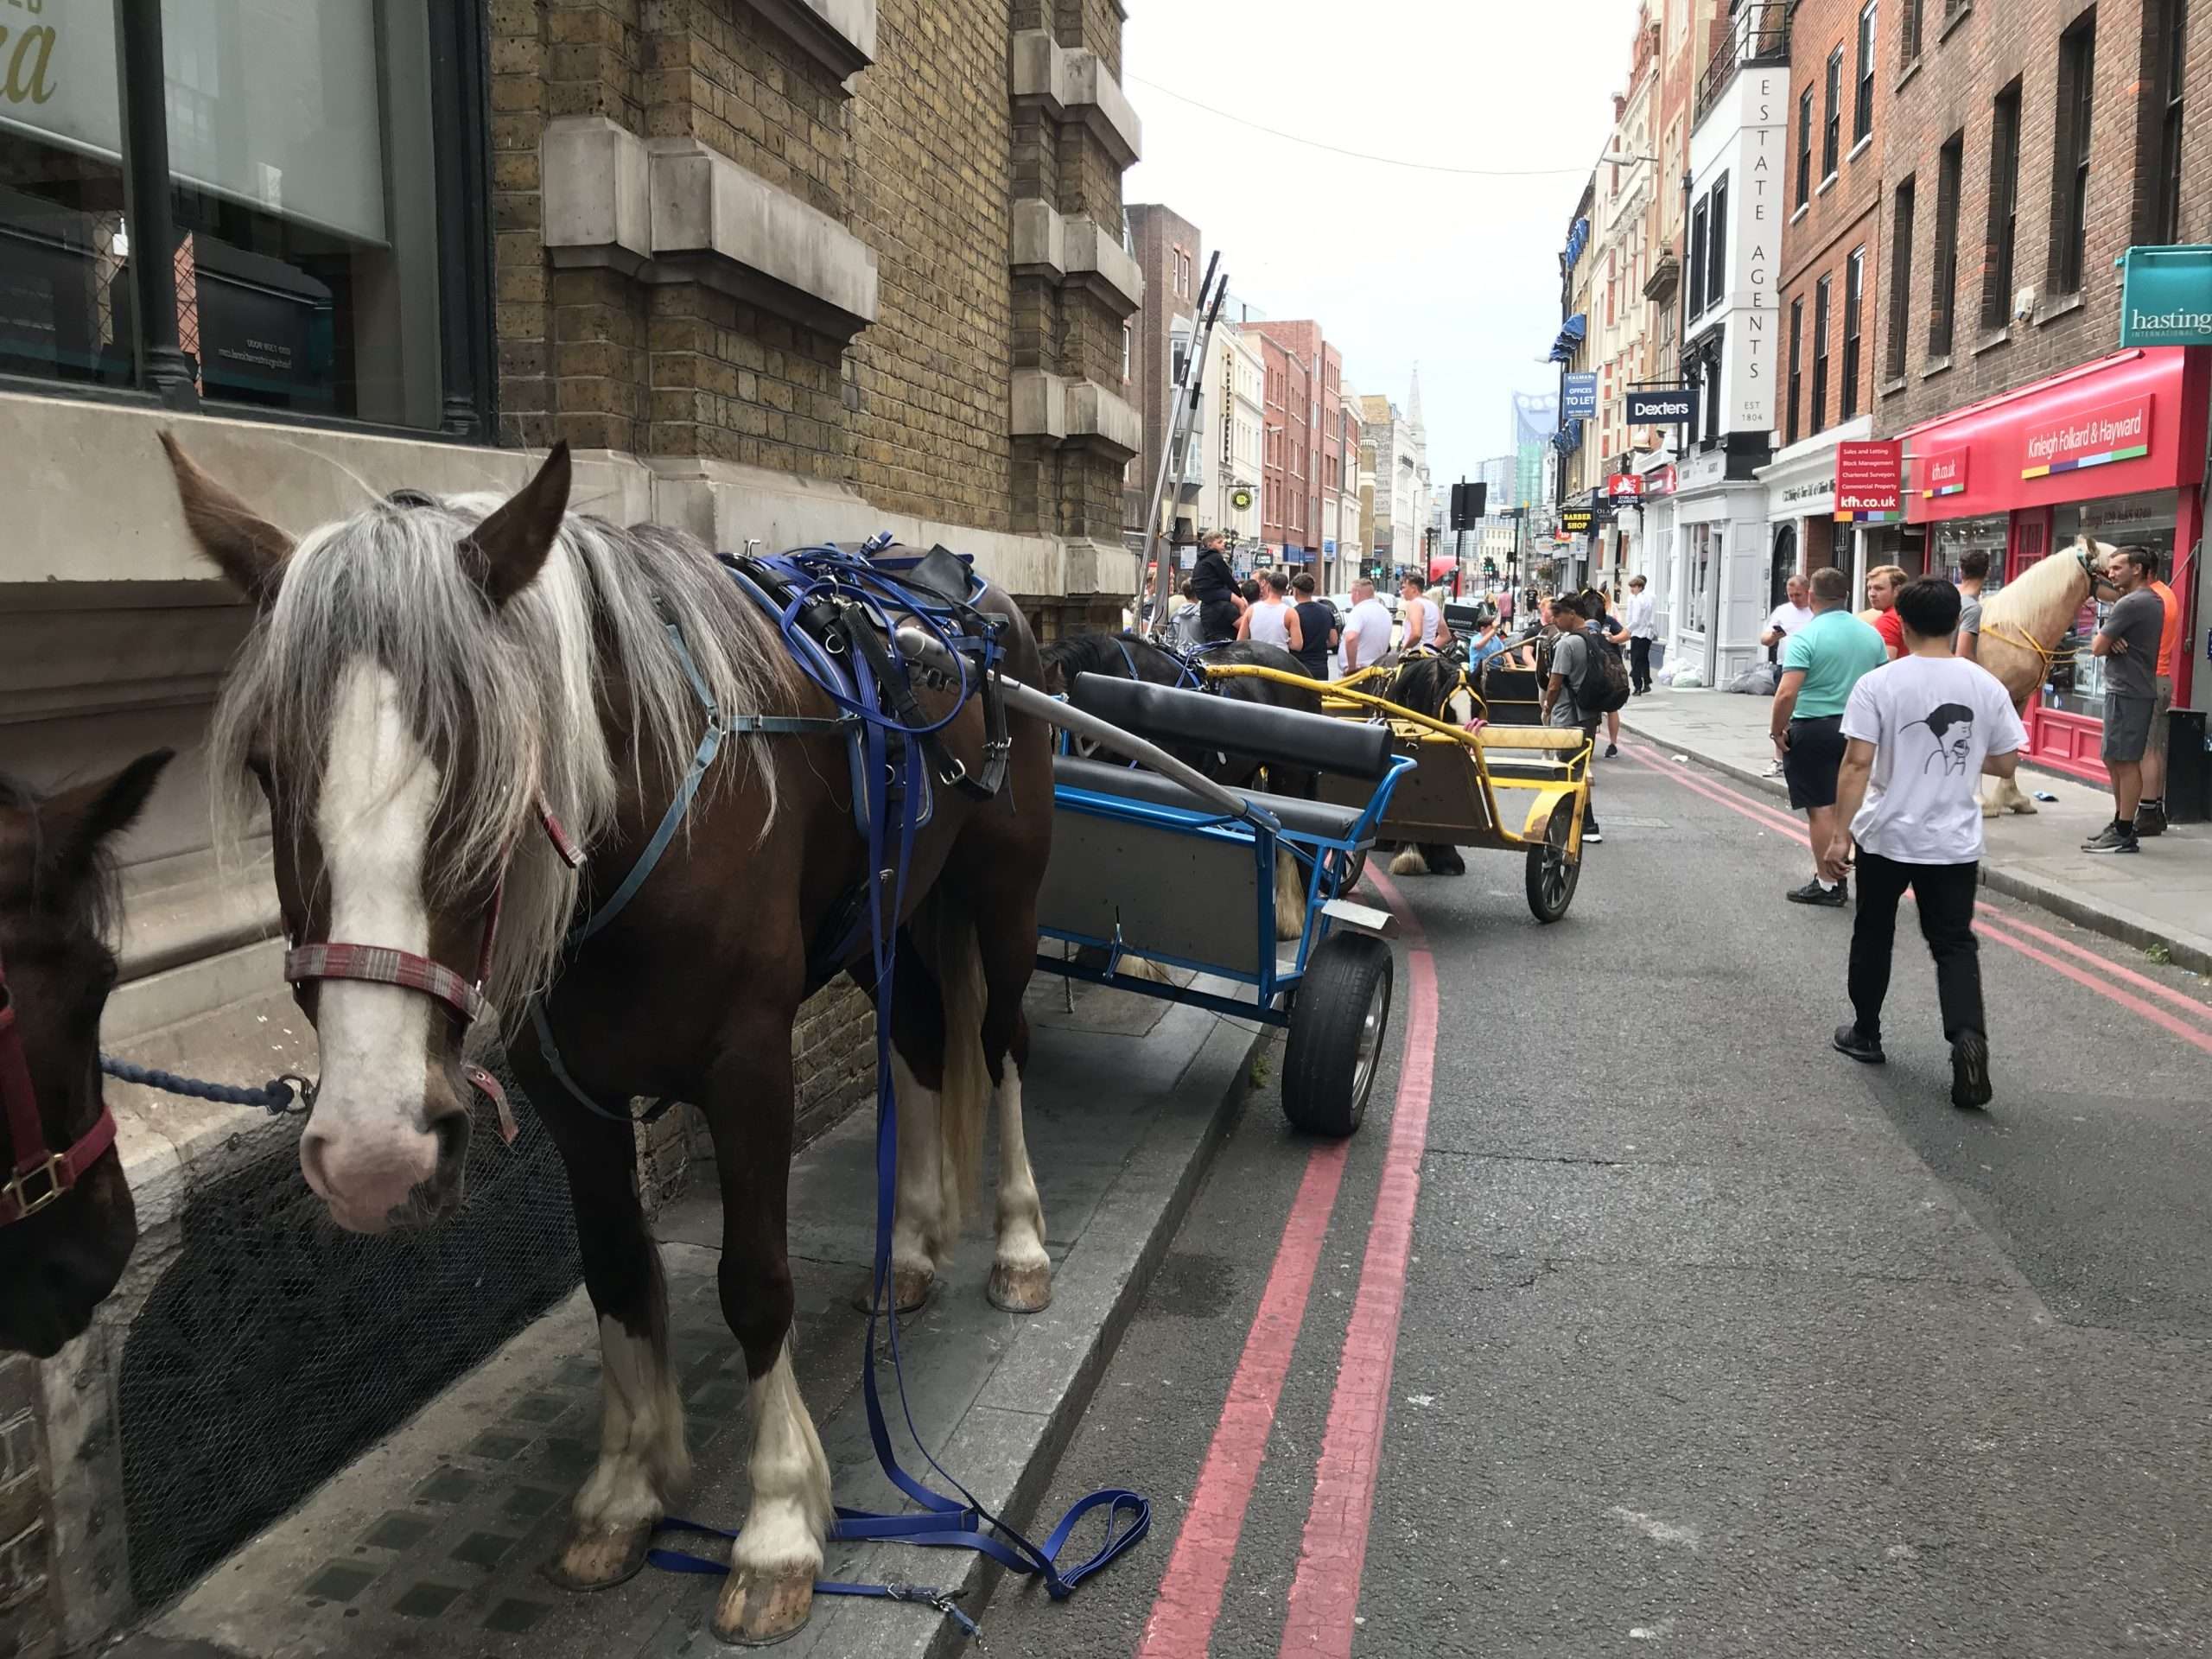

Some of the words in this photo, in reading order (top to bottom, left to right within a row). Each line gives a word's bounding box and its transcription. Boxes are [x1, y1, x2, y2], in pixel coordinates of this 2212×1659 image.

[1754, 79, 1770, 220] ESTATE
[1749, 245, 1765, 378] AGENTS
[2131, 329, 2195, 338] INTERNATIONAL
[1566, 397, 1579, 405] TO
[1580, 396, 1595, 405] LET
[1744, 401, 1761, 410] EST
[1635, 402, 1689, 416] Dexters
[2028, 434, 2059, 460] Kinleigh
[2059, 423, 2090, 451] Folkard
[2090, 425, 2098, 445] &
[2099, 409, 2142, 446] Hayward
[1931, 459, 1956, 481] kfh.co.uk
[1840, 495, 1896, 508] kfh.co.uk
